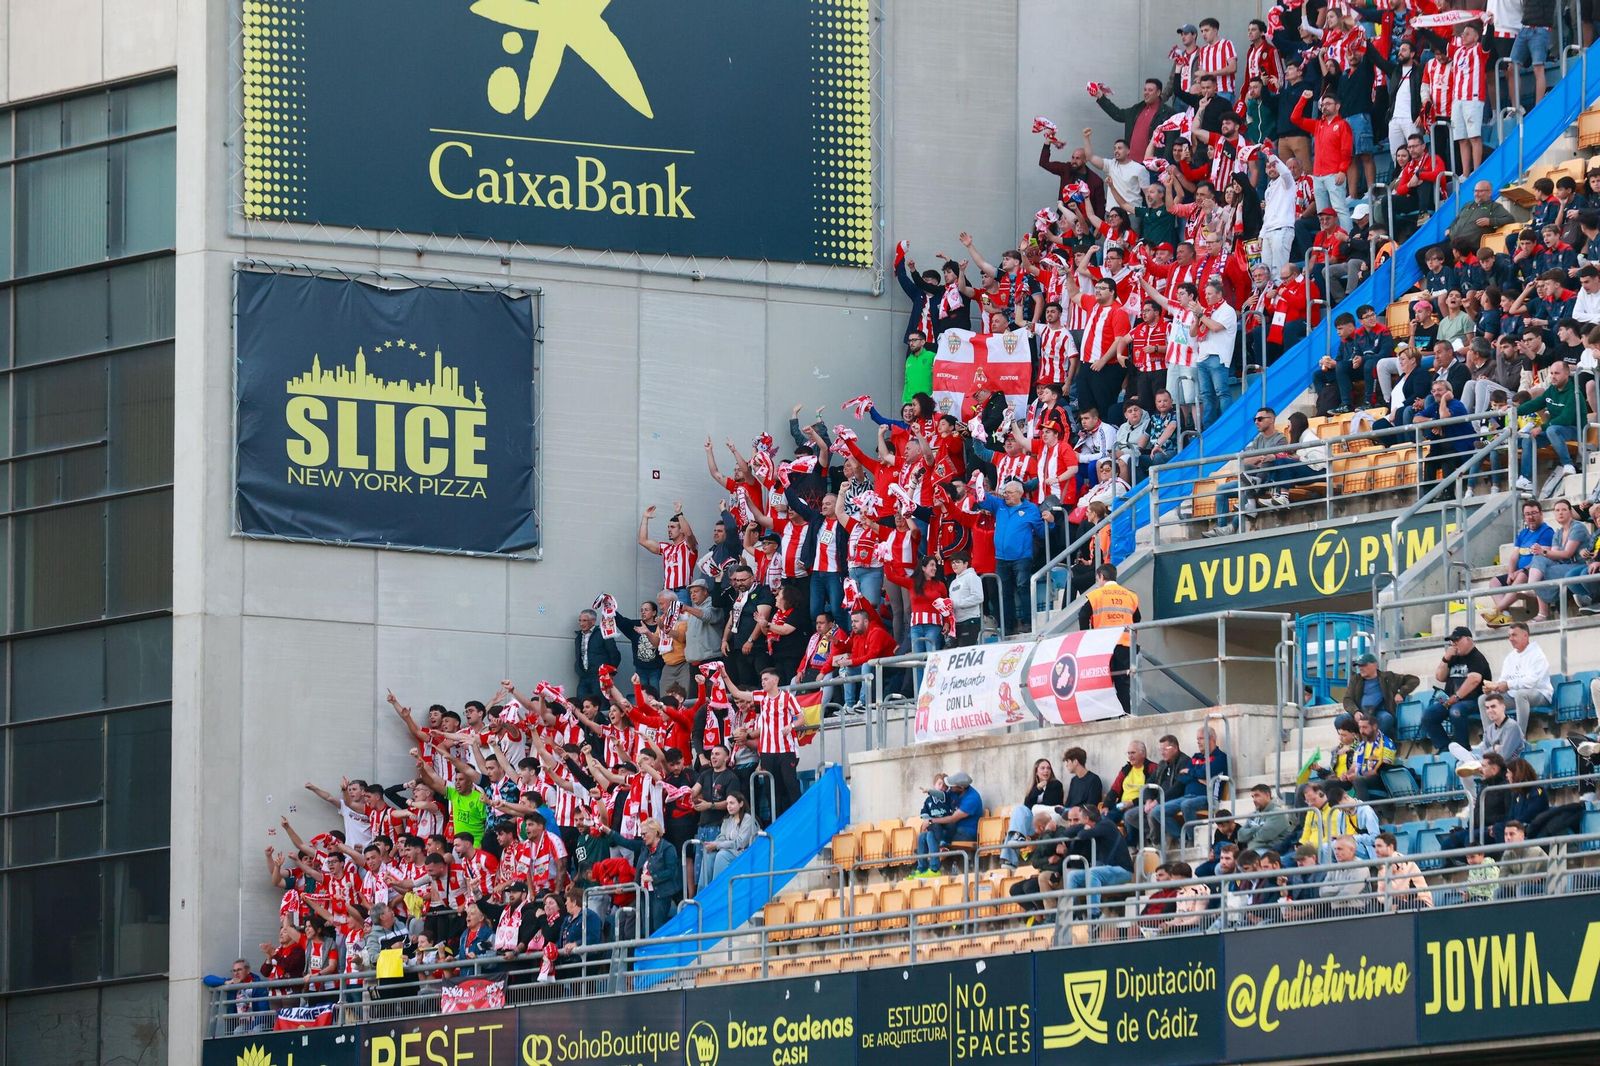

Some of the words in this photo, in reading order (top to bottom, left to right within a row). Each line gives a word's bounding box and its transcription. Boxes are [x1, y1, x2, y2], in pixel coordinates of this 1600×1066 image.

[429, 140, 695, 219] CaixaBank
[286, 395, 488, 478] SLICE
[287, 466, 344, 488] NEW
[349, 471, 413, 494] YORK
[419, 477, 488, 499] PIZZA
[1173, 548, 1298, 604] AYUDA
[1359, 523, 1457, 577] PYM
[947, 648, 985, 671] PEÑA
[946, 696, 961, 711] CON
[963, 694, 974, 708] LA
[950, 709, 993, 731] ALMERÍA
[1116, 961, 1216, 1000] Diputación
[1424, 931, 1543, 1015] JOYMA
[956, 982, 987, 1009] NO
[888, 1002, 948, 1028] ESTUDIO
[956, 1004, 1030, 1035] LIMITS
[1116, 1015, 1139, 1043] de
[1147, 1008, 1198, 1041] Cádiz
[557, 1026, 680, 1063] SohoBoutique
[727, 1018, 768, 1049] Díaz
[772, 1015, 854, 1044] Cadenas
[862, 1033, 874, 1048] DE
[877, 1026, 948, 1048] ARQUITECTURA
[956, 1031, 1031, 1059] SPACES
[772, 1045, 808, 1066] CASH
